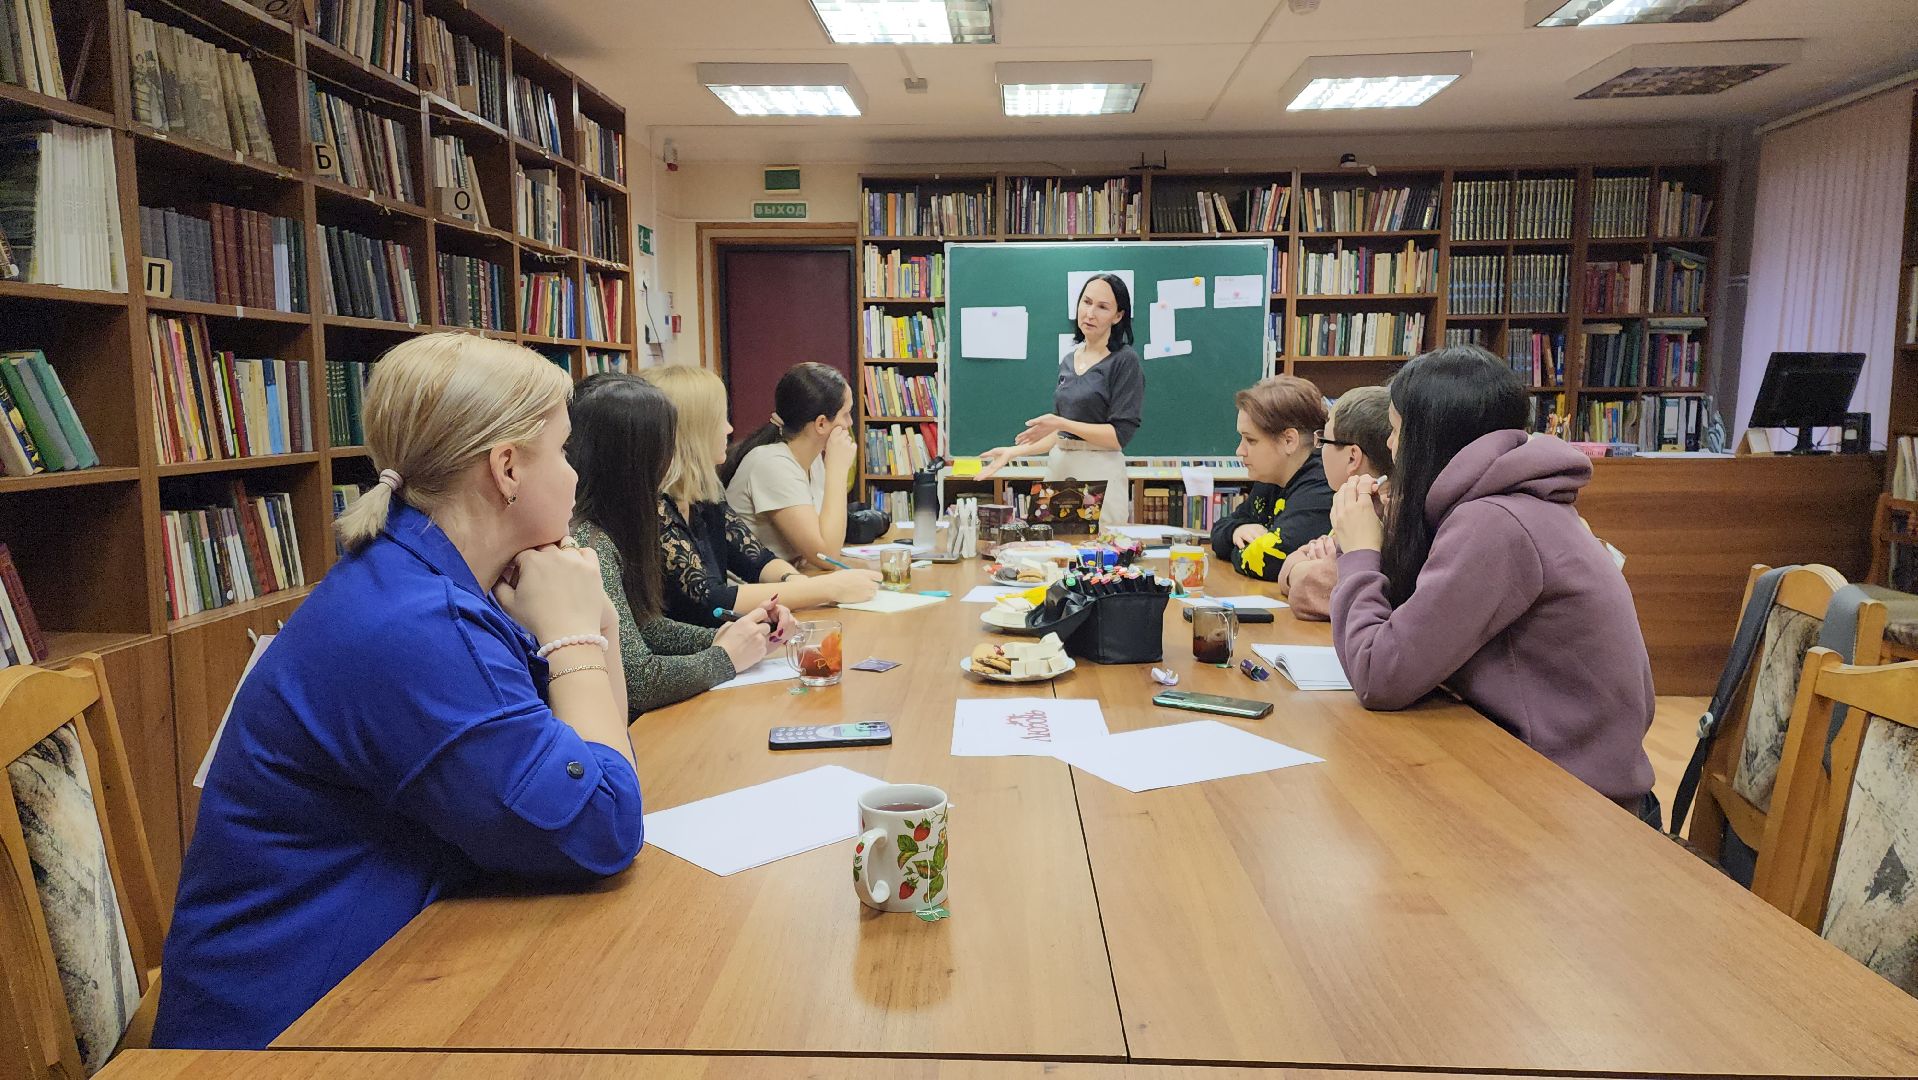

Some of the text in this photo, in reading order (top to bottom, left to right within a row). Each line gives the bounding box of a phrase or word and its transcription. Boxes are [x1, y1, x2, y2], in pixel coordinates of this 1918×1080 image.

[315, 145, 332, 170] Б
[454, 191, 471, 211] О
[756, 205, 805, 217] ВЫХОД
[146, 262, 165, 291] П
